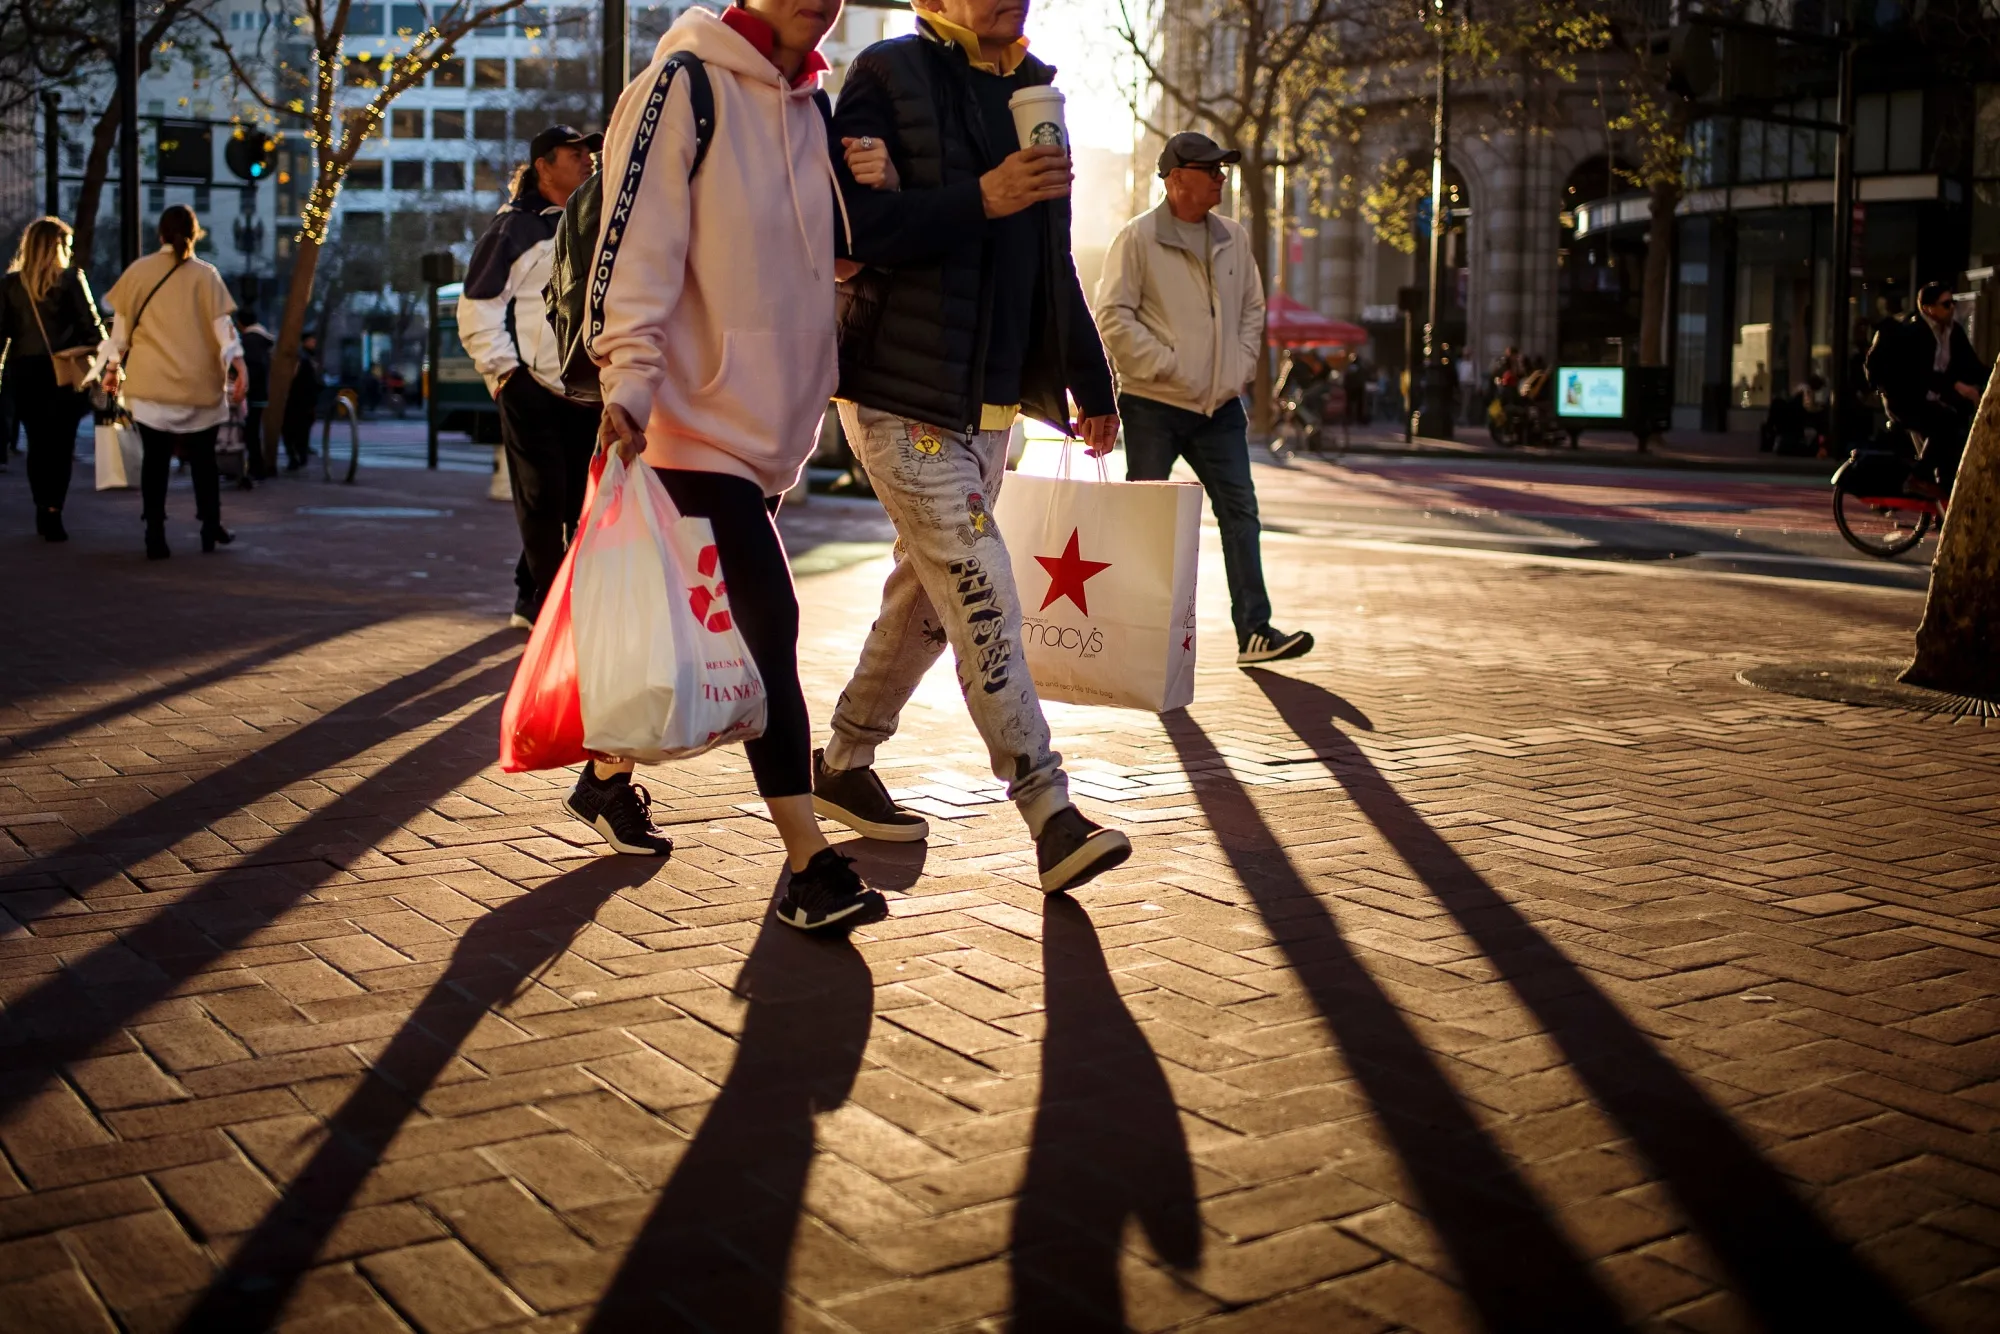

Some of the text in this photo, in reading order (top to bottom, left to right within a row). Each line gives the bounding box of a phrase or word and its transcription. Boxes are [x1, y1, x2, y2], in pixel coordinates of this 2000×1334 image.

[638, 91, 663, 152] PONY
[615, 161, 642, 222] PINK
[592, 250, 613, 310] PONY
[1021, 622, 1104, 658] macy's
